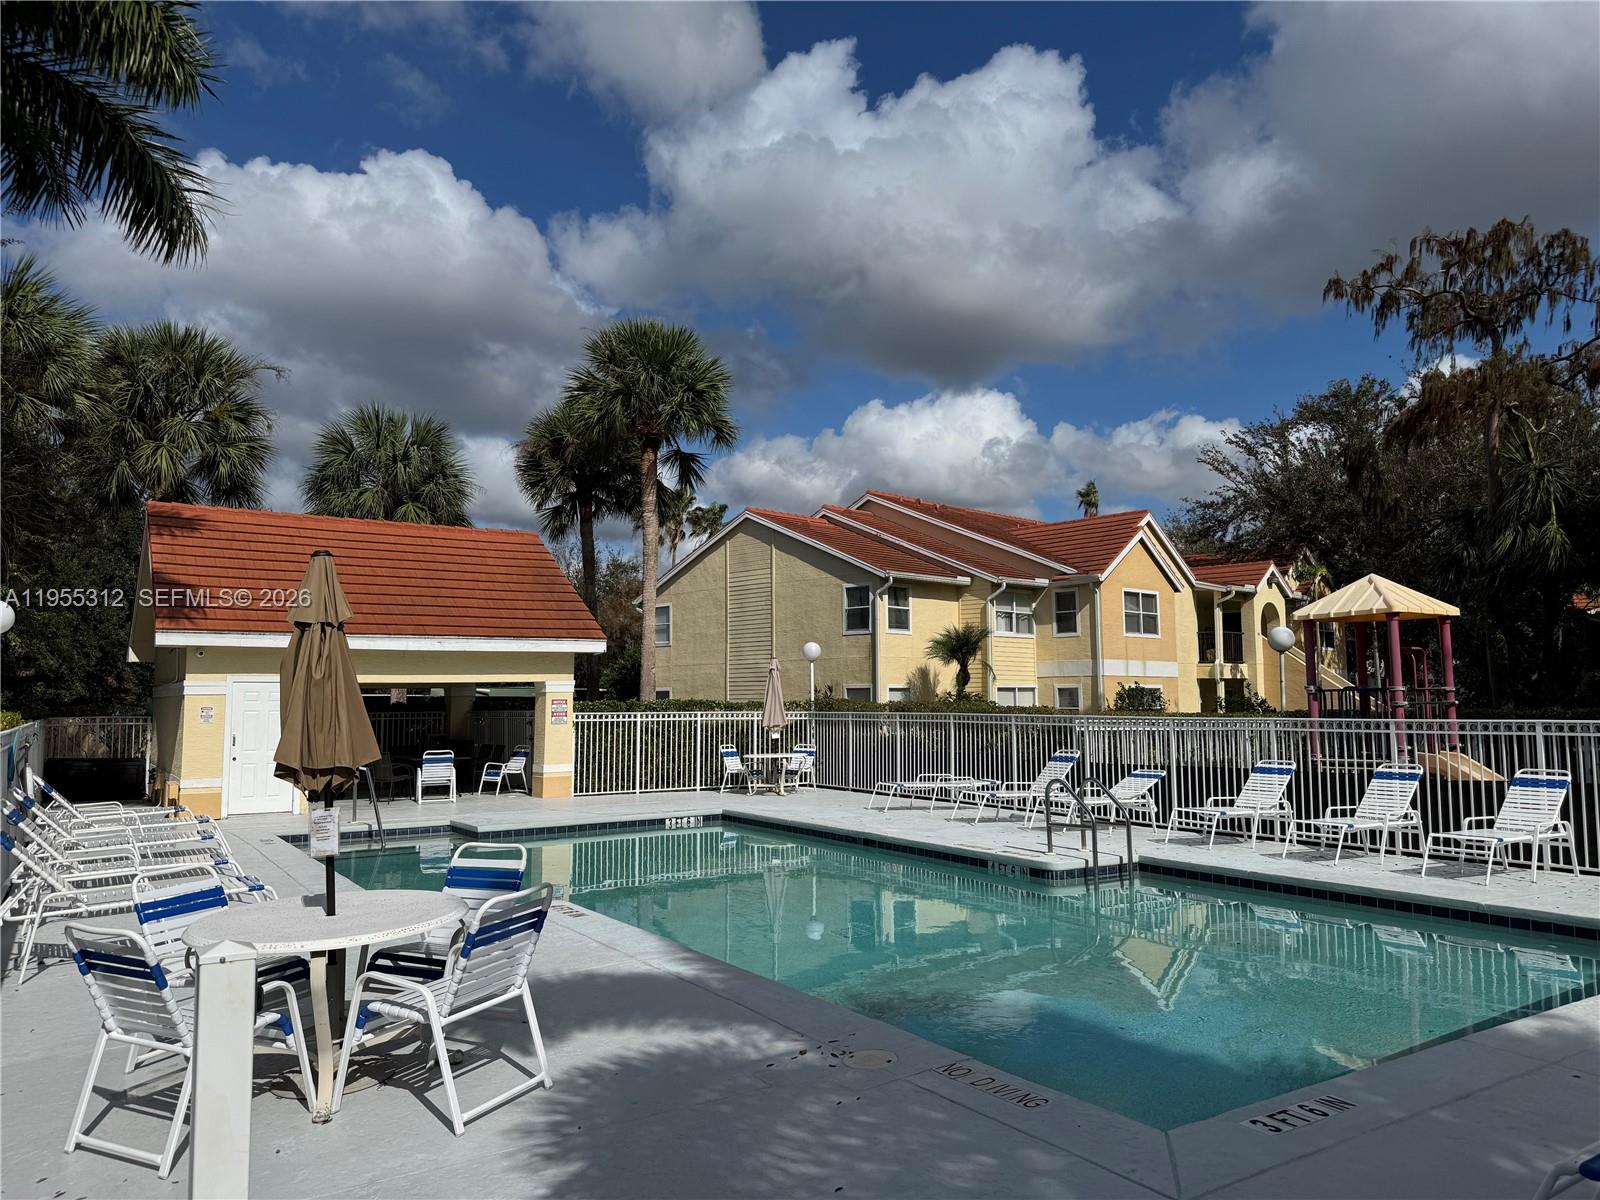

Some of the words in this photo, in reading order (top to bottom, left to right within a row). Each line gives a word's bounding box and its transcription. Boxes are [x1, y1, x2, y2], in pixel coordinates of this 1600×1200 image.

[935, 1062, 972, 1079] NO
[969, 1077, 1049, 1108] DIVING
[1297, 1104, 1330, 1117] 6
[1313, 1095, 1358, 1111] IN
[1249, 1119, 1282, 1133] 3
[1265, 1109, 1311, 1128] FT
